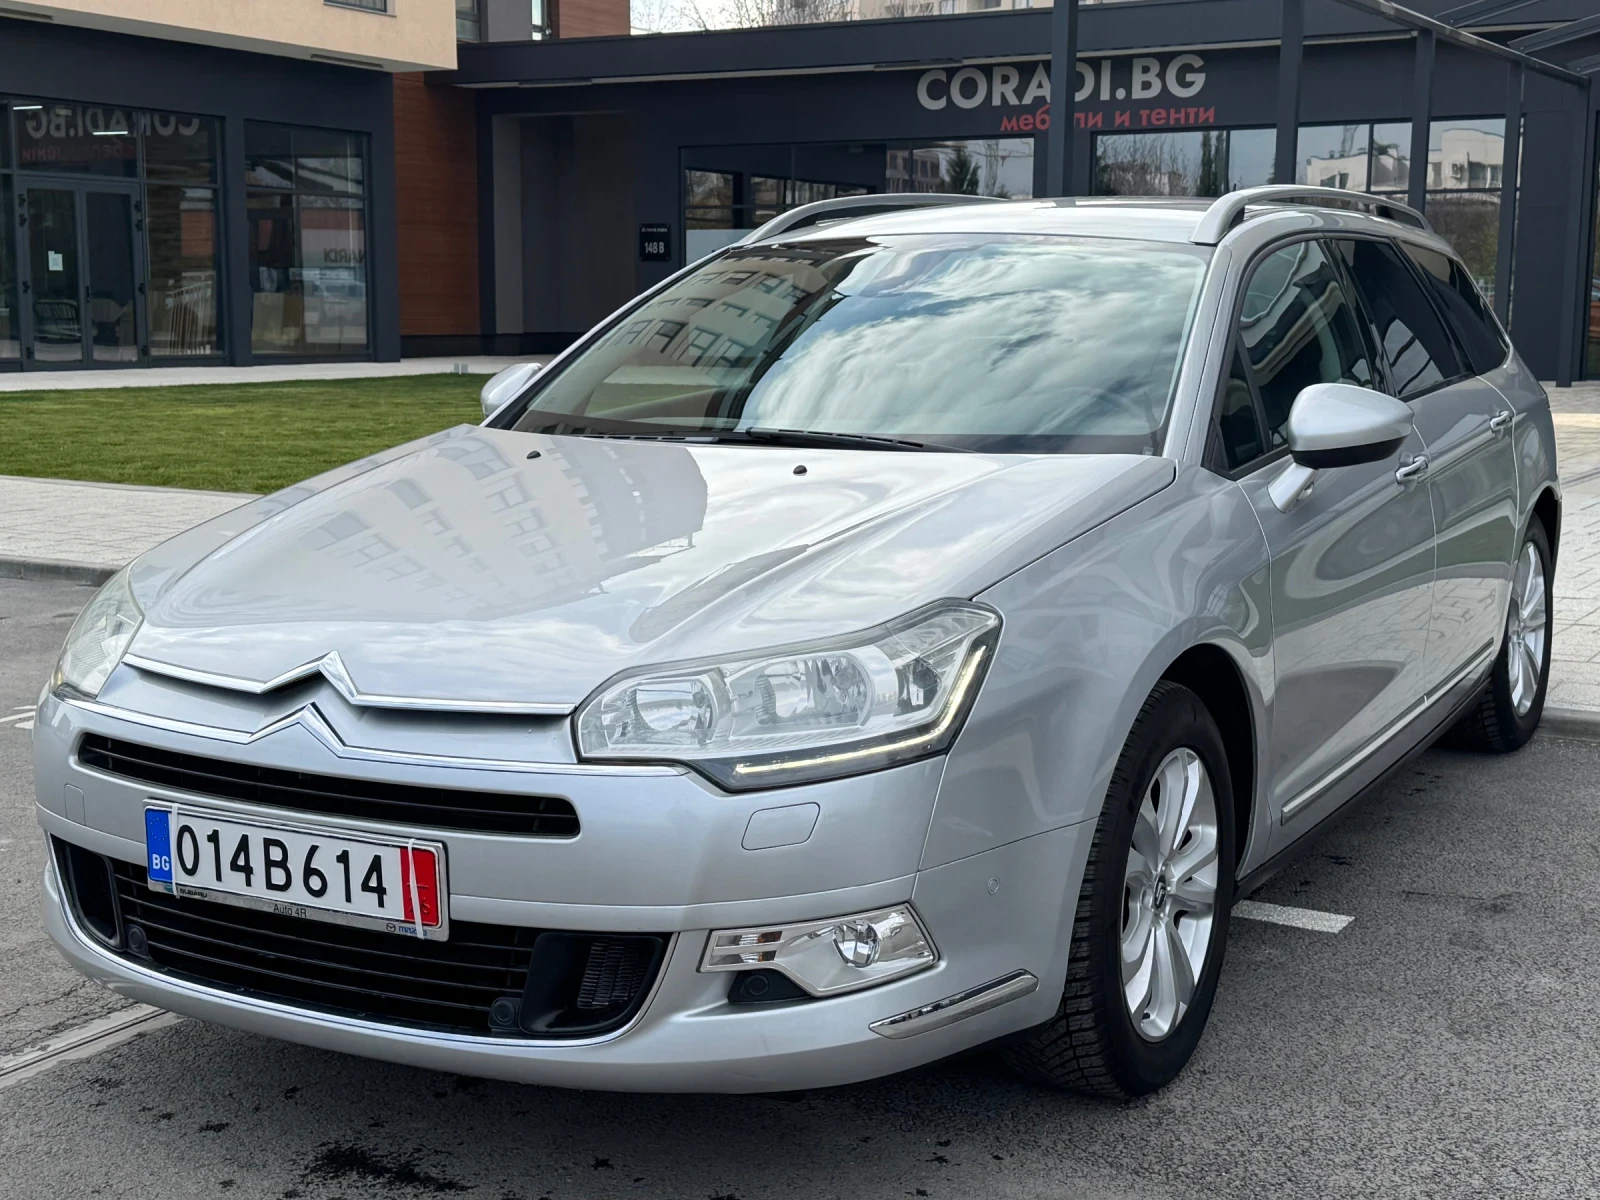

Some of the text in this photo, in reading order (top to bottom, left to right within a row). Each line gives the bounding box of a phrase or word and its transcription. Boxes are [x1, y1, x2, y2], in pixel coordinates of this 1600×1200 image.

[917, 54, 1206, 110] CORADI.BG
[1000, 104, 1215, 131] мебли и тенти
[644, 242, 657, 254] 148
[152, 853, 170, 871] BG
[176, 824, 387, 909] 014B614
[180, 888, 207, 898] SUBARU
[273, 904, 307, 918] Auto 4R
[399, 926, 427, 936] maza
